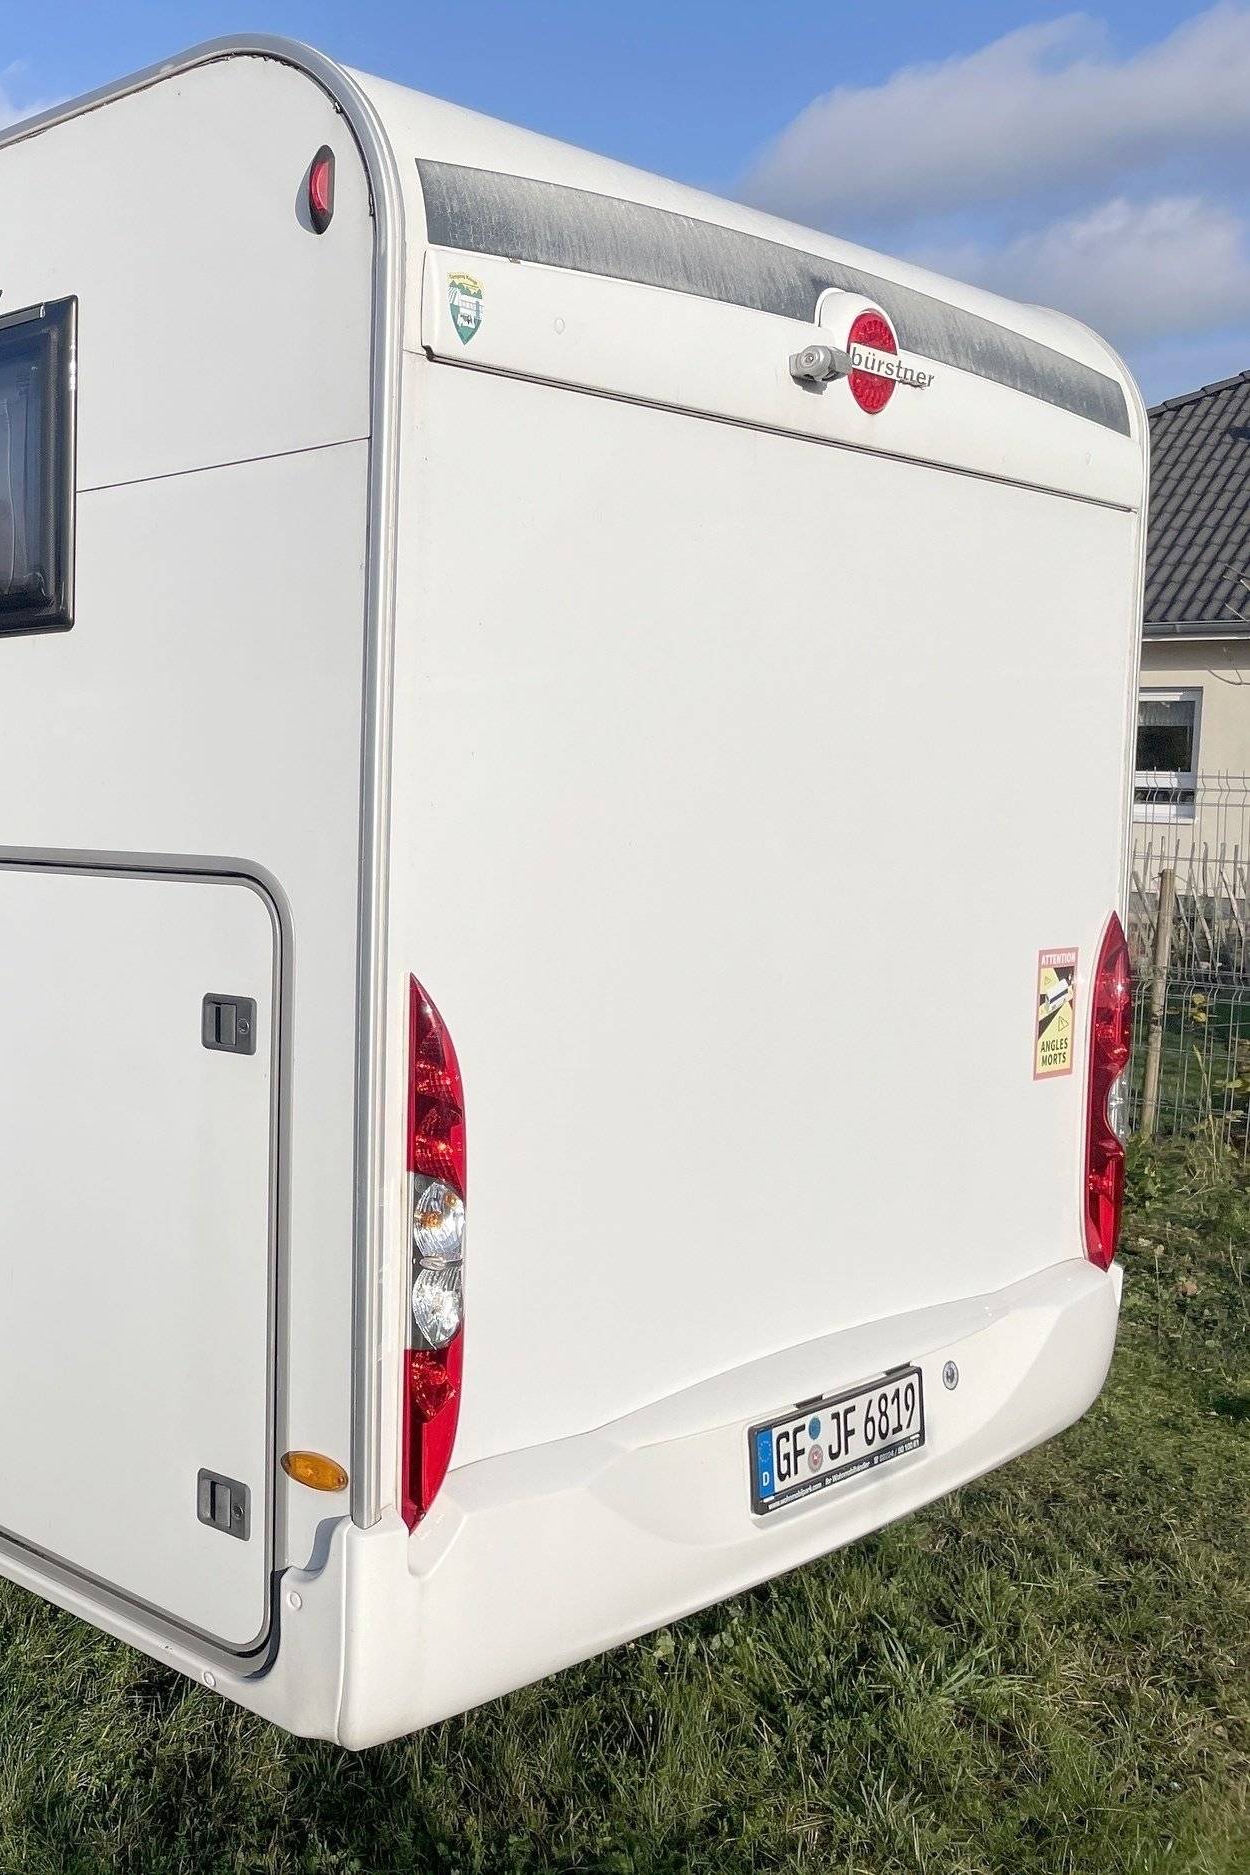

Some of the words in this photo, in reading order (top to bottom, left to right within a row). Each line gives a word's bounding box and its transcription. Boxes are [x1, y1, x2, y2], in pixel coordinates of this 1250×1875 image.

[851, 346, 935, 388] bürstner
[1040, 952, 1076, 966] ATTENTION
[1040, 1037, 1068, 1053] ANGLES
[1041, 1052, 1067, 1067] MORTS
[775, 1423, 806, 1482] GF
[828, 1405, 856, 1461] JF
[863, 1382, 916, 1447] 6819
[762, 1471, 770, 1487] D
